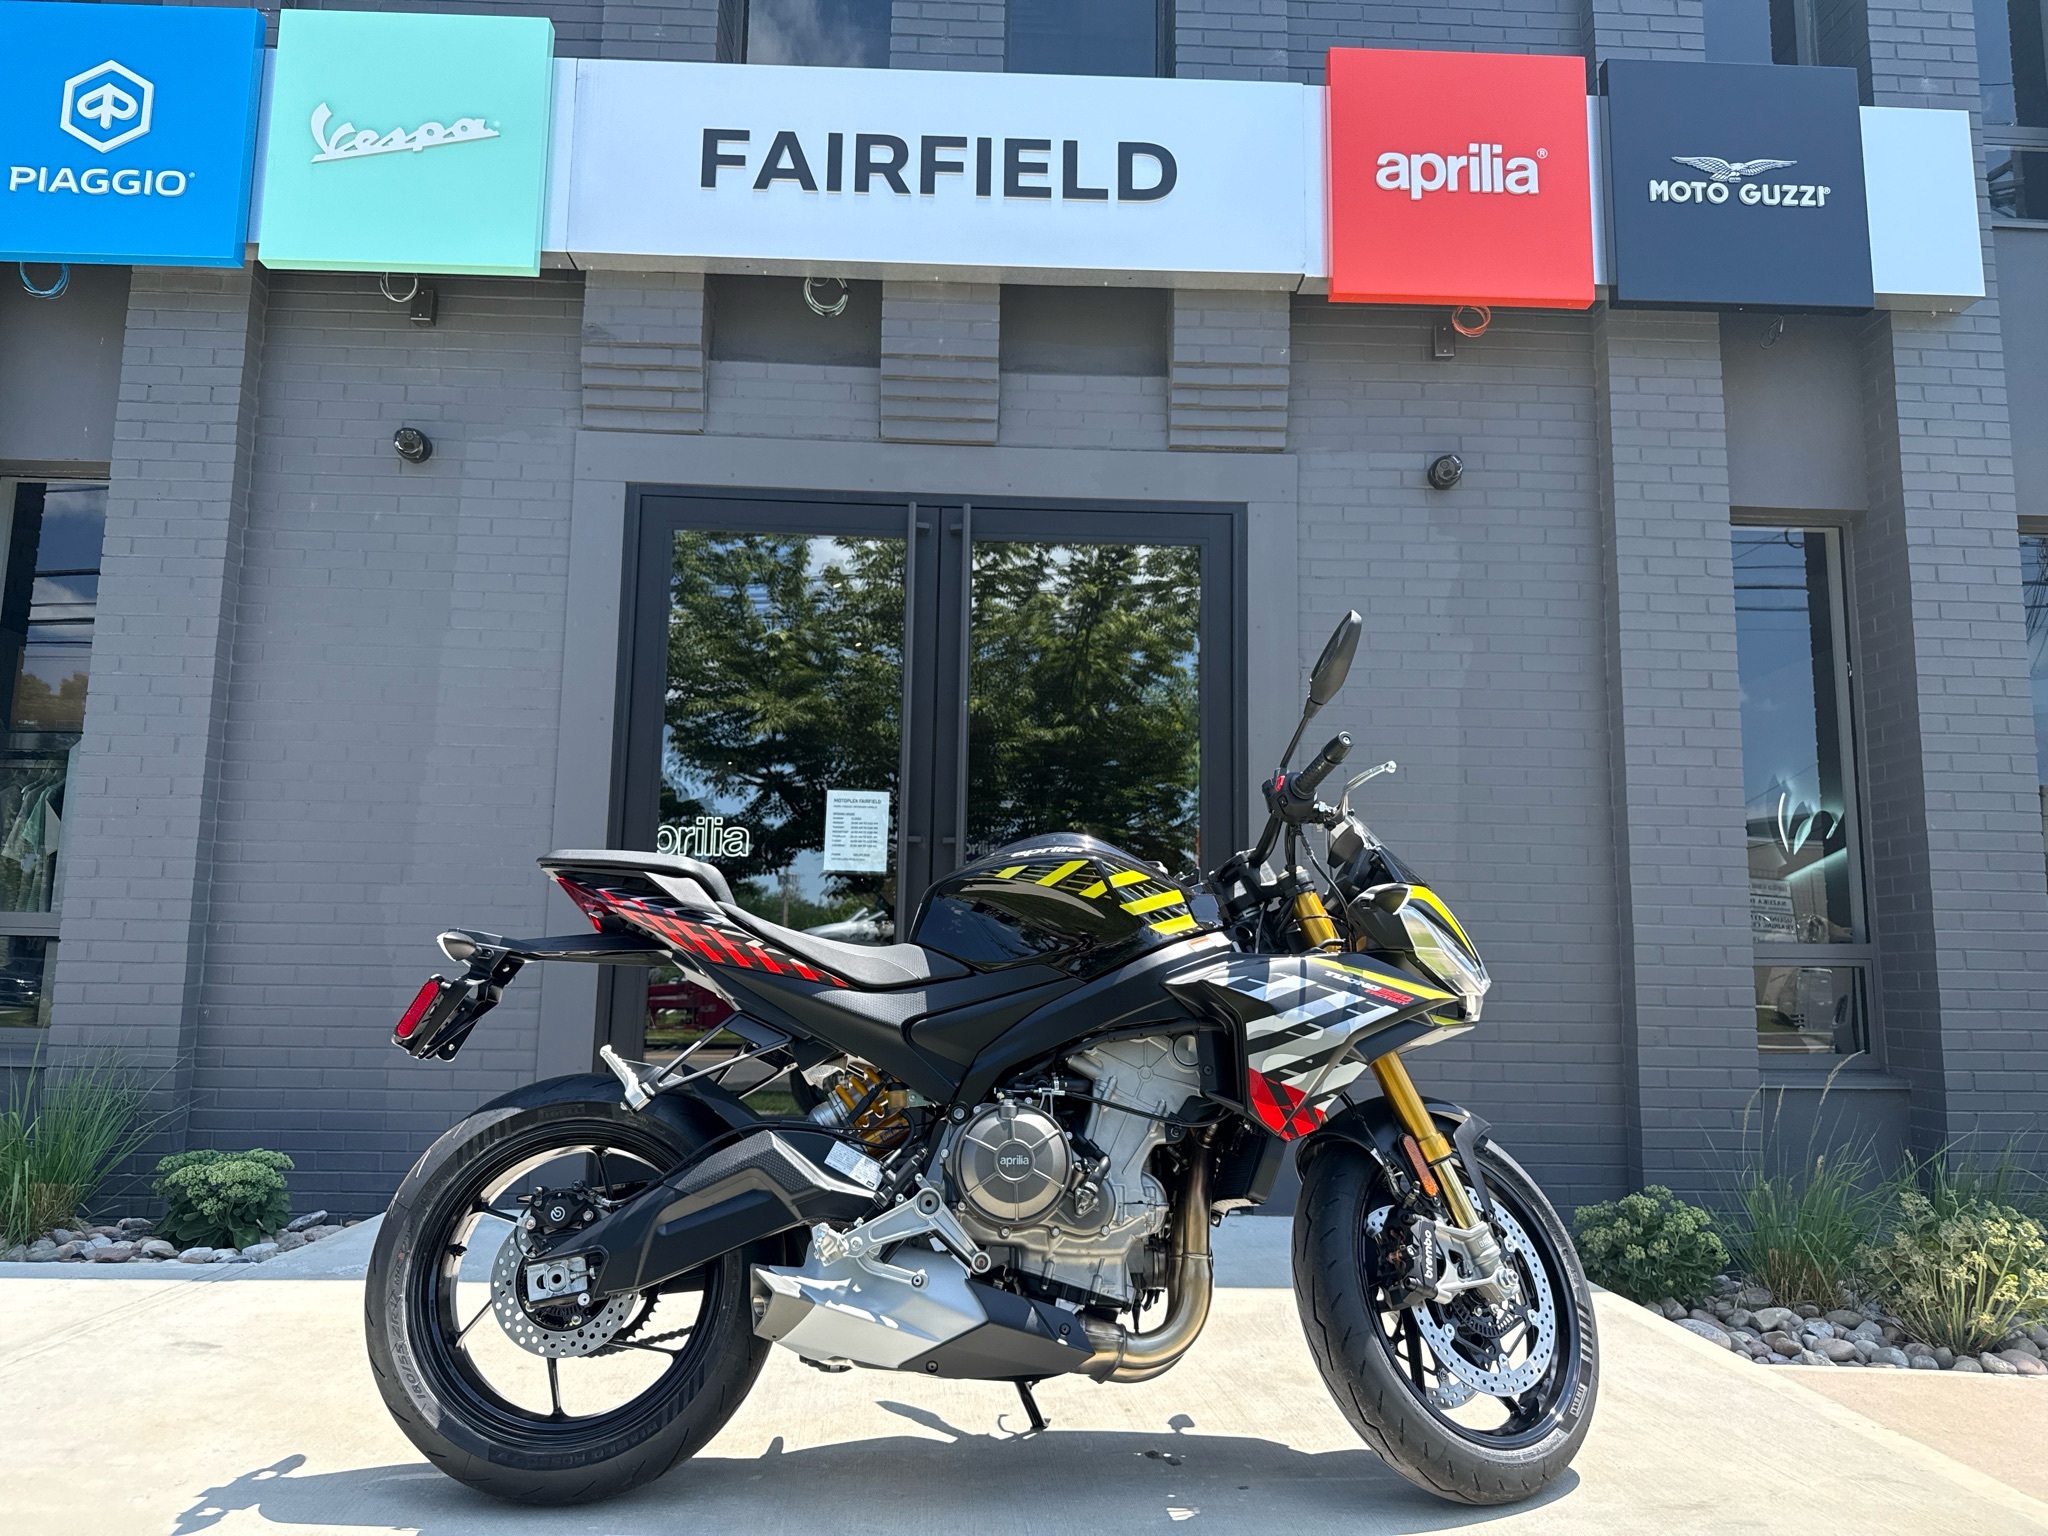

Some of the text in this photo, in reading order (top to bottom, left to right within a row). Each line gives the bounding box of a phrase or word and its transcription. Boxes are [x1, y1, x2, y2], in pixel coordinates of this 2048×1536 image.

[310, 102, 500, 164] Vespa
[9, 166, 188, 198] PIAGGIO
[700, 128, 1178, 203] FAIRFIELD
[1375, 142, 1540, 201] aprilia
[1649, 179, 1826, 208] MOTO GUZZI
[657, 816, 750, 857] prilia
[1010, 846, 1085, 858] aprilia
[1325, 970, 1382, 992] TUONO
[999, 1154, 1030, 1168] aprilia
[1424, 1229, 1434, 1279] brembo
